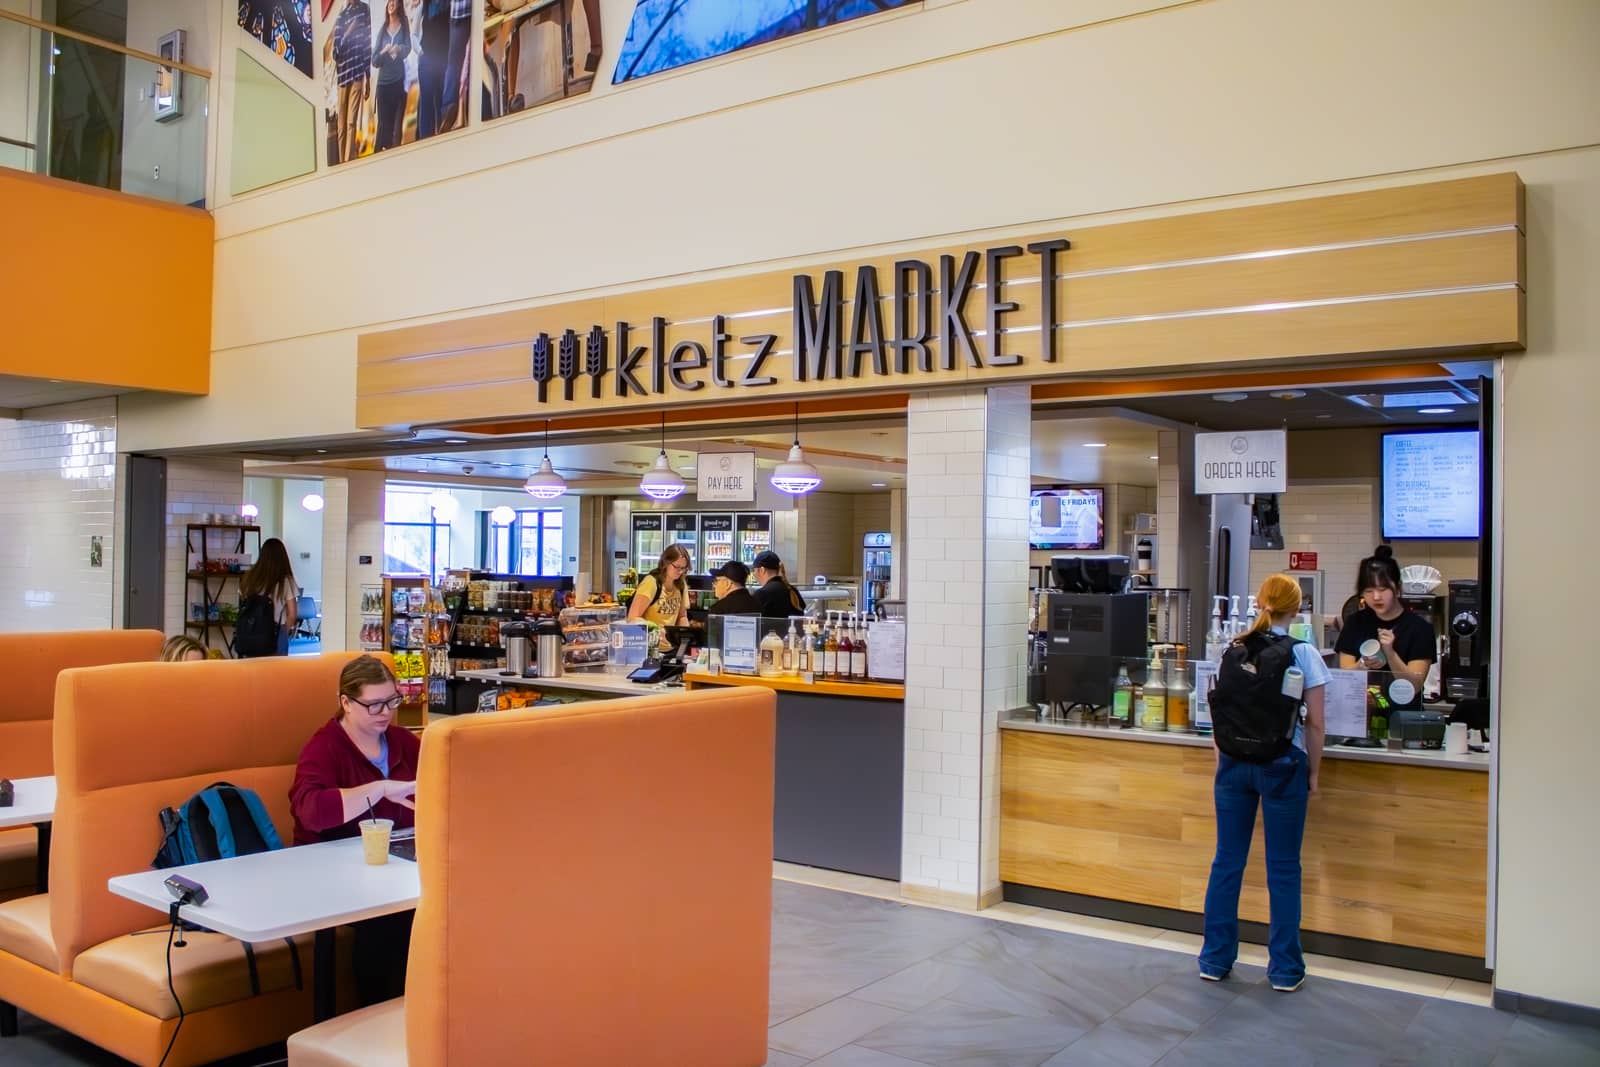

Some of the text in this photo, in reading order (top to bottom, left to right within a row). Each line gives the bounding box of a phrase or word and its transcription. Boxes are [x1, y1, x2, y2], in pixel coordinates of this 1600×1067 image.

[616, 239, 1071, 396] kletz MARKET
[1204, 460, 1277, 479] ORDER HERE
[707, 476, 743, 490] PAY HERE
[1067, 498, 1096, 506] FRIDAYS
